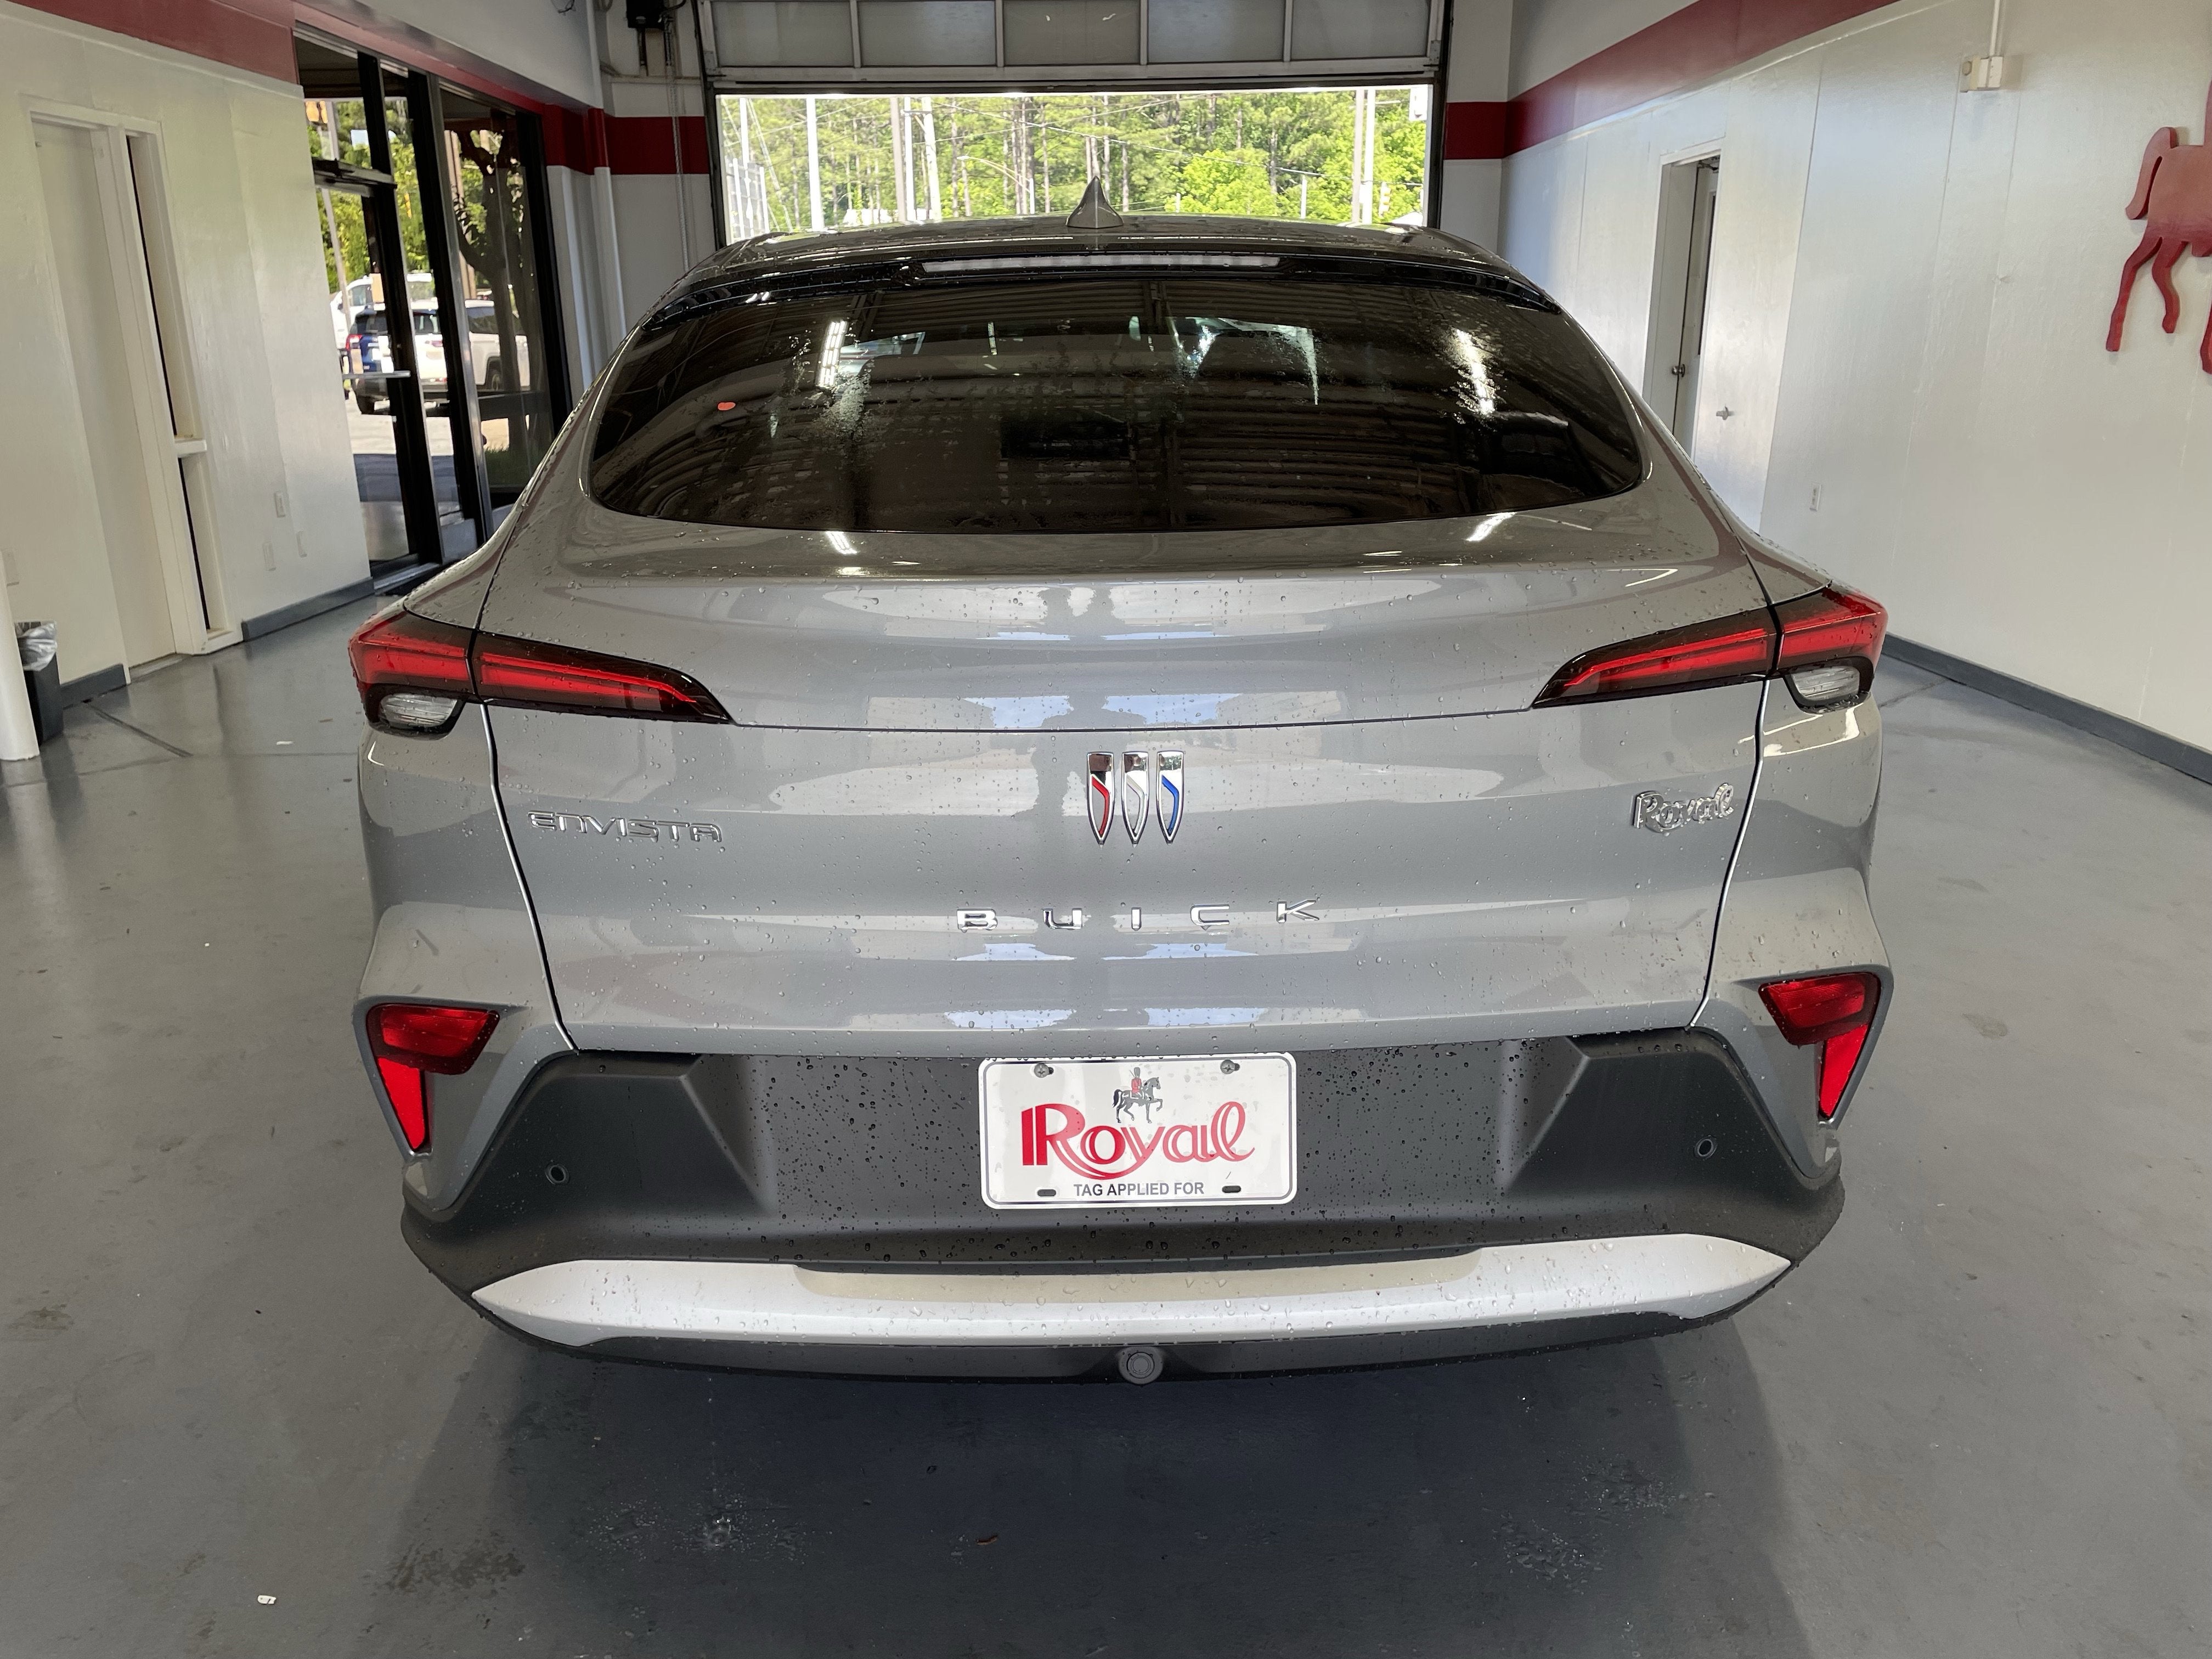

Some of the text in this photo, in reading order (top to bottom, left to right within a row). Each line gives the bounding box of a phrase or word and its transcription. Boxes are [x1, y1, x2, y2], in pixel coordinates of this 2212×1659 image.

[527, 810, 722, 843] ENVISTA
[956, 900, 1319, 931] BUICK
[1021, 1101, 1255, 1180] Royal
[1073, 1182, 1205, 1197] TAG APPLIED FOR
